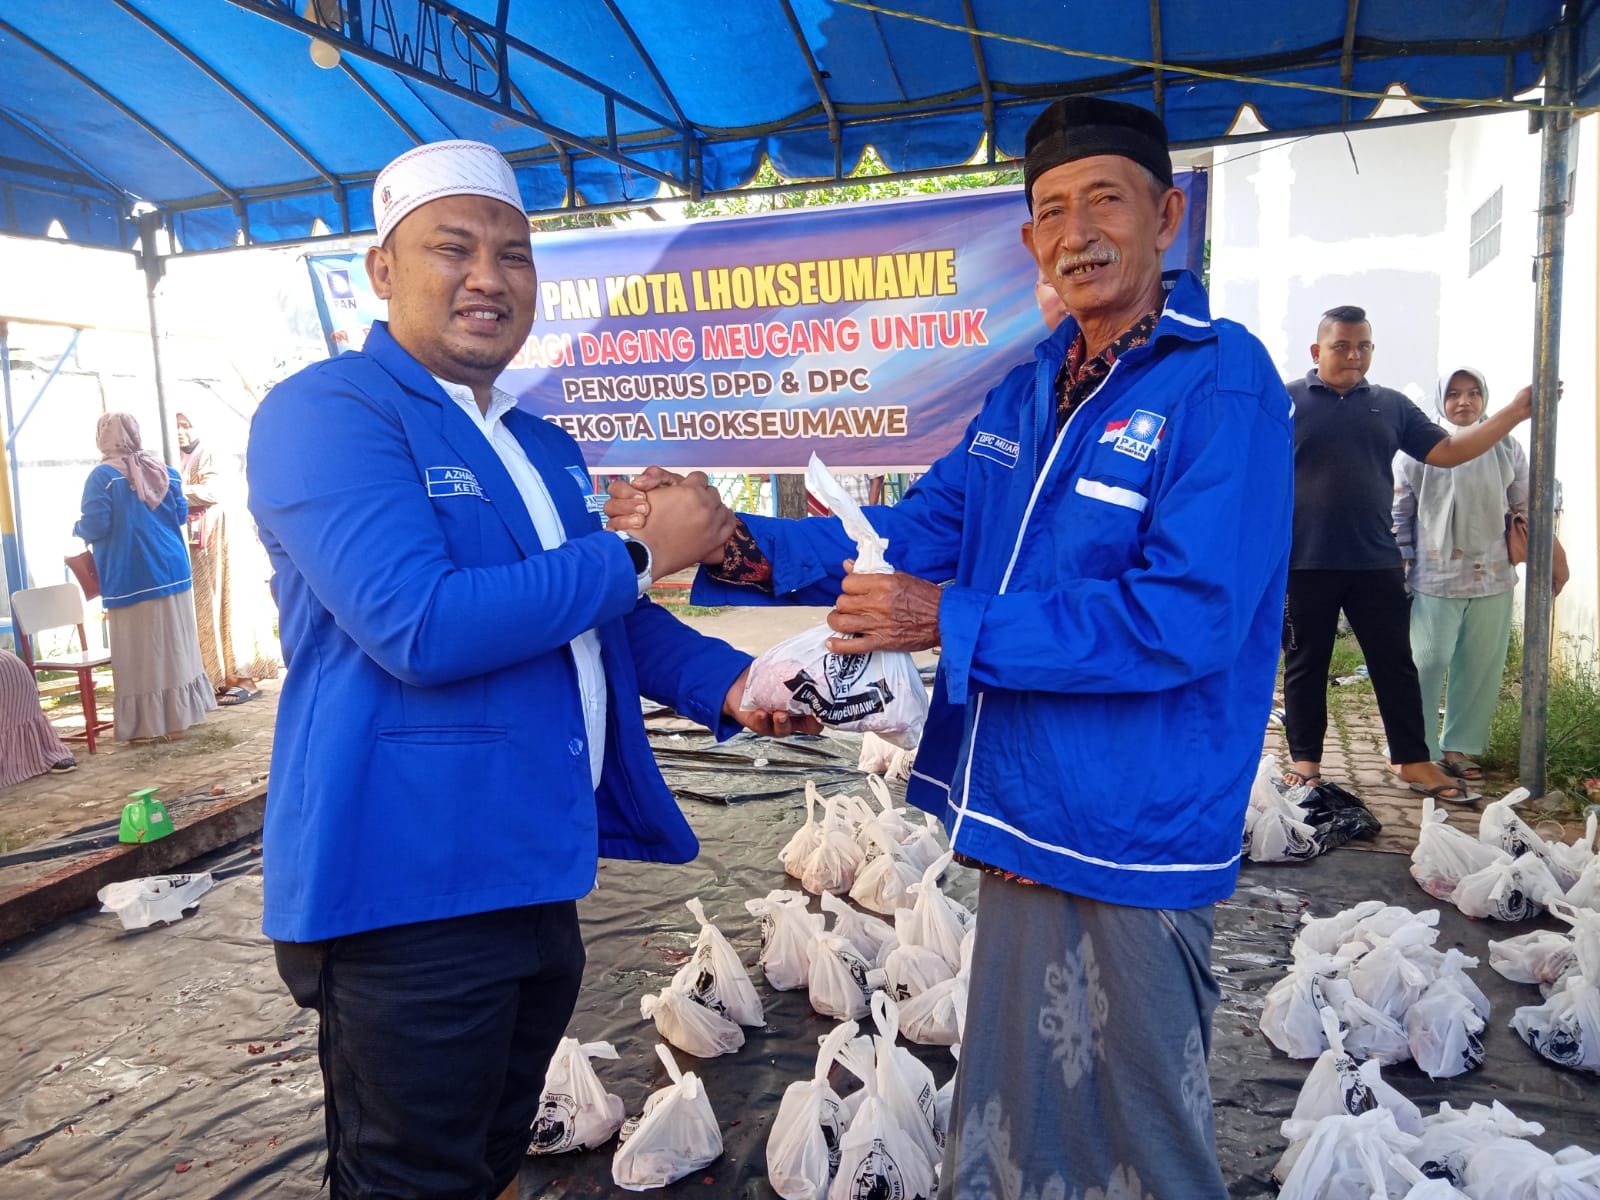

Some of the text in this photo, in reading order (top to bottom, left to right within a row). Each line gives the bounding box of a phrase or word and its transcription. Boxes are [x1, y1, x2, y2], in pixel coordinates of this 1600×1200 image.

[540, 249, 957, 321] PAN KOTA LHOKSEUMAWE
[579, 327, 695, 366] DAGING
[701, 317, 862, 361] MEUGANG
[869, 309, 989, 350] UNTUK
[563, 367, 871, 403] PENGURUS DPD & DPC
[543, 405, 907, 441] EKOTA LHOKSEUMAWE
[994, 439, 1019, 455] MUAR
[1120, 438, 1149, 454] PAN
